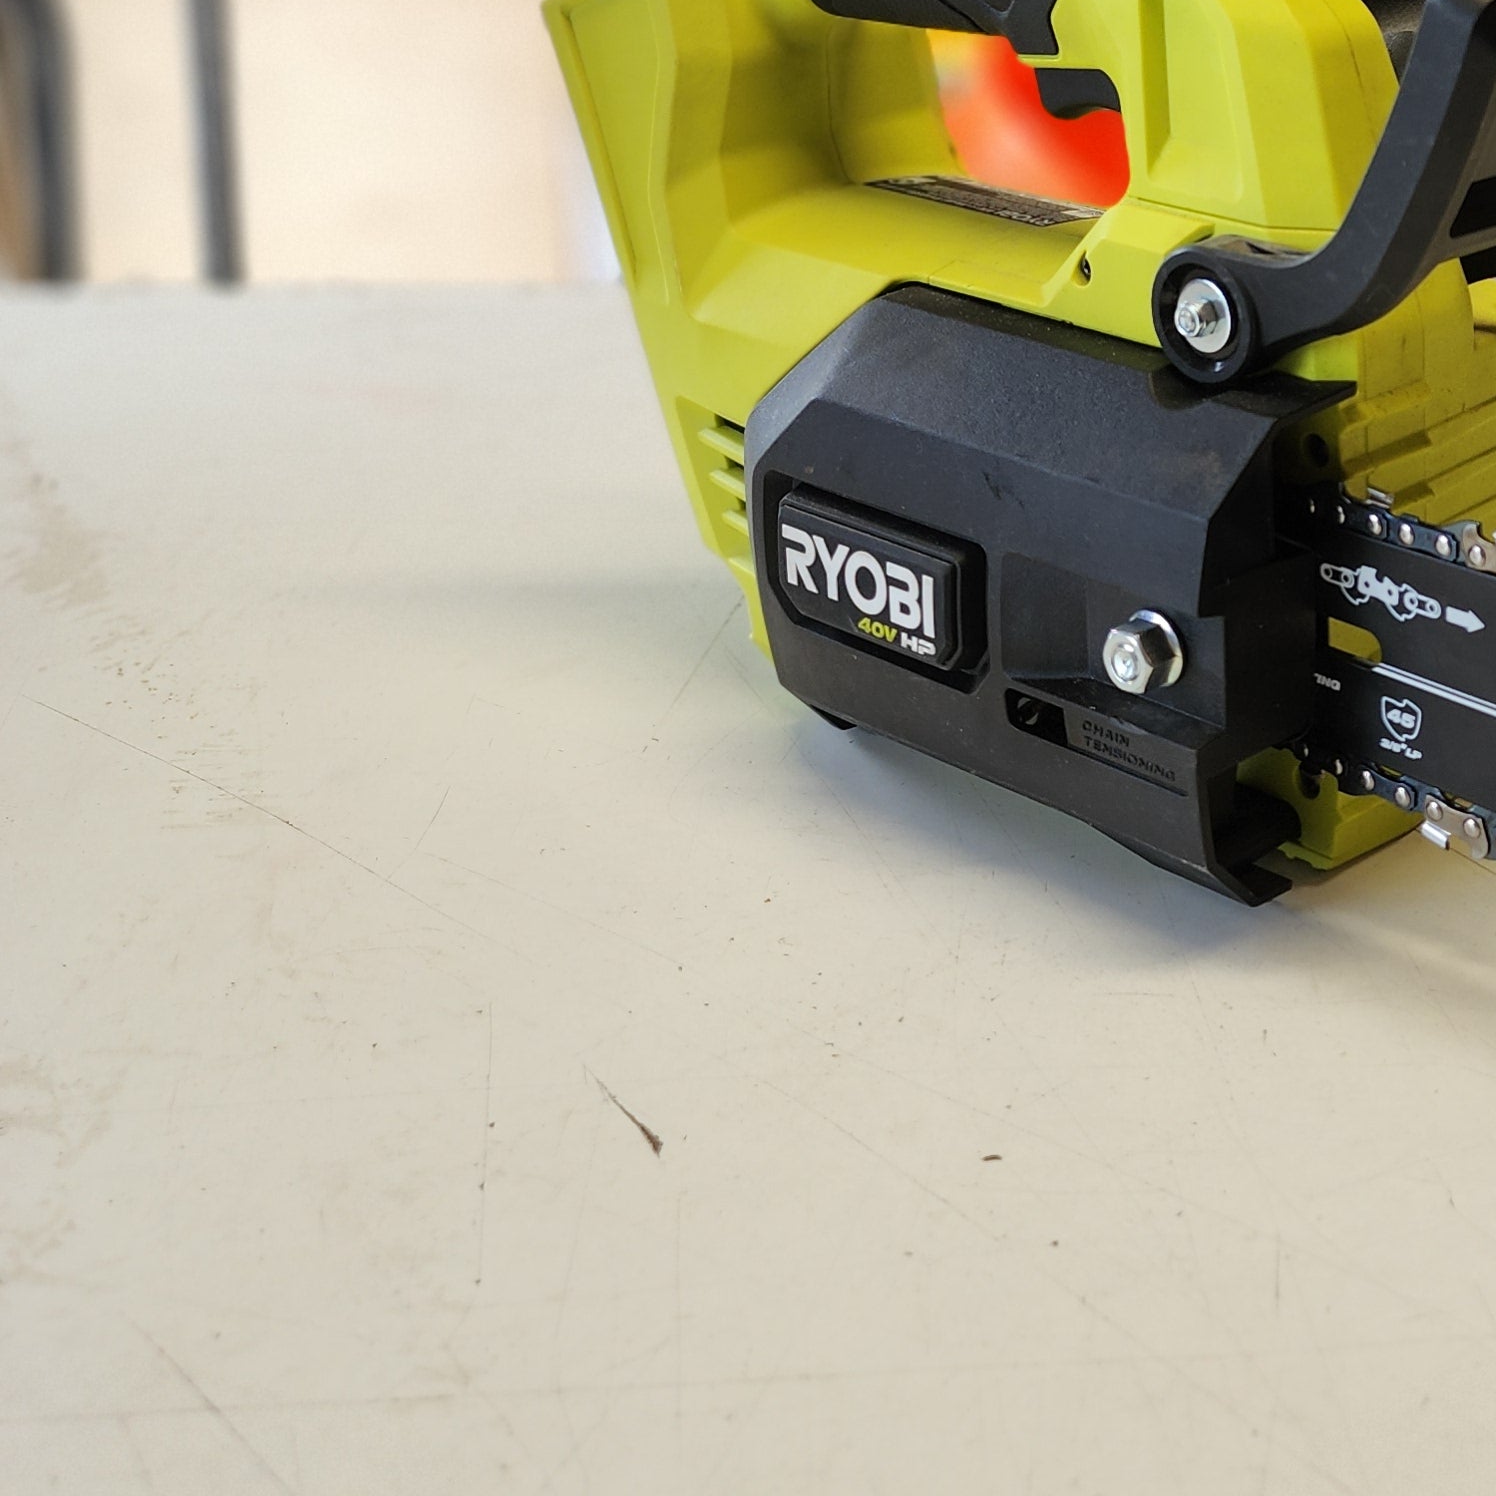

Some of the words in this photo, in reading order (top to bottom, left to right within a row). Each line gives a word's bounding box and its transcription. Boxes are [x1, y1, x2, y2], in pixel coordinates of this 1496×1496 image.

[781, 523, 936, 640] RYOBI
[857, 616, 899, 643] 40V
[900, 631, 937, 656] HP
[1082, 719, 1130, 747] CHAIN
[1083, 735, 1176, 782] TENSIONING
